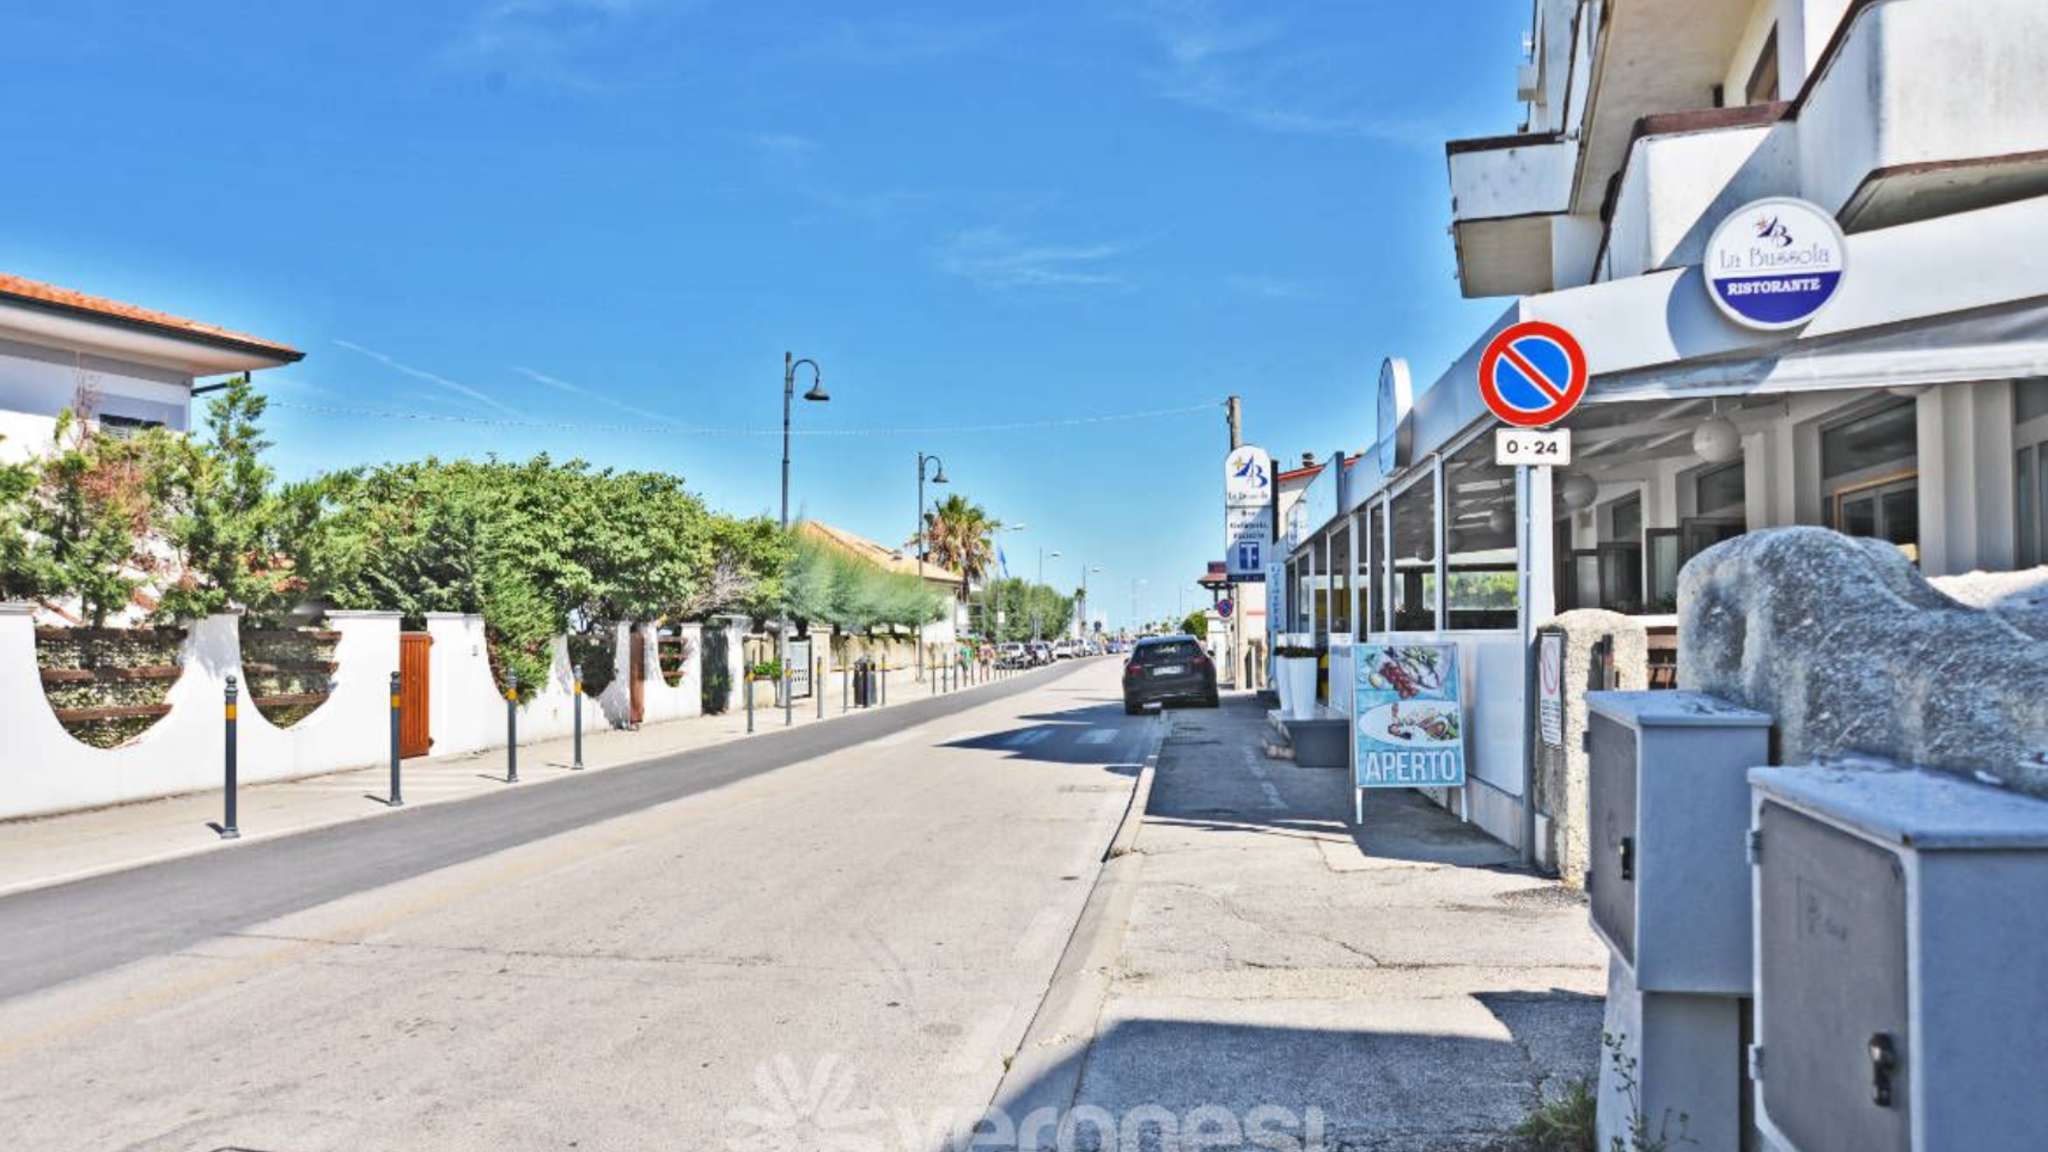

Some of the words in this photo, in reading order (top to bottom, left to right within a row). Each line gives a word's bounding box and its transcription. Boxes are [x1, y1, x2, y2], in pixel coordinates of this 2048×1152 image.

[1720, 248, 1741, 268] La
[1749, 242, 1829, 268] Bussola
[1727, 278, 1821, 295] RISTORANTE
[1534, 440, 1559, 454] 24
[1364, 750, 1456, 782] APERTO
